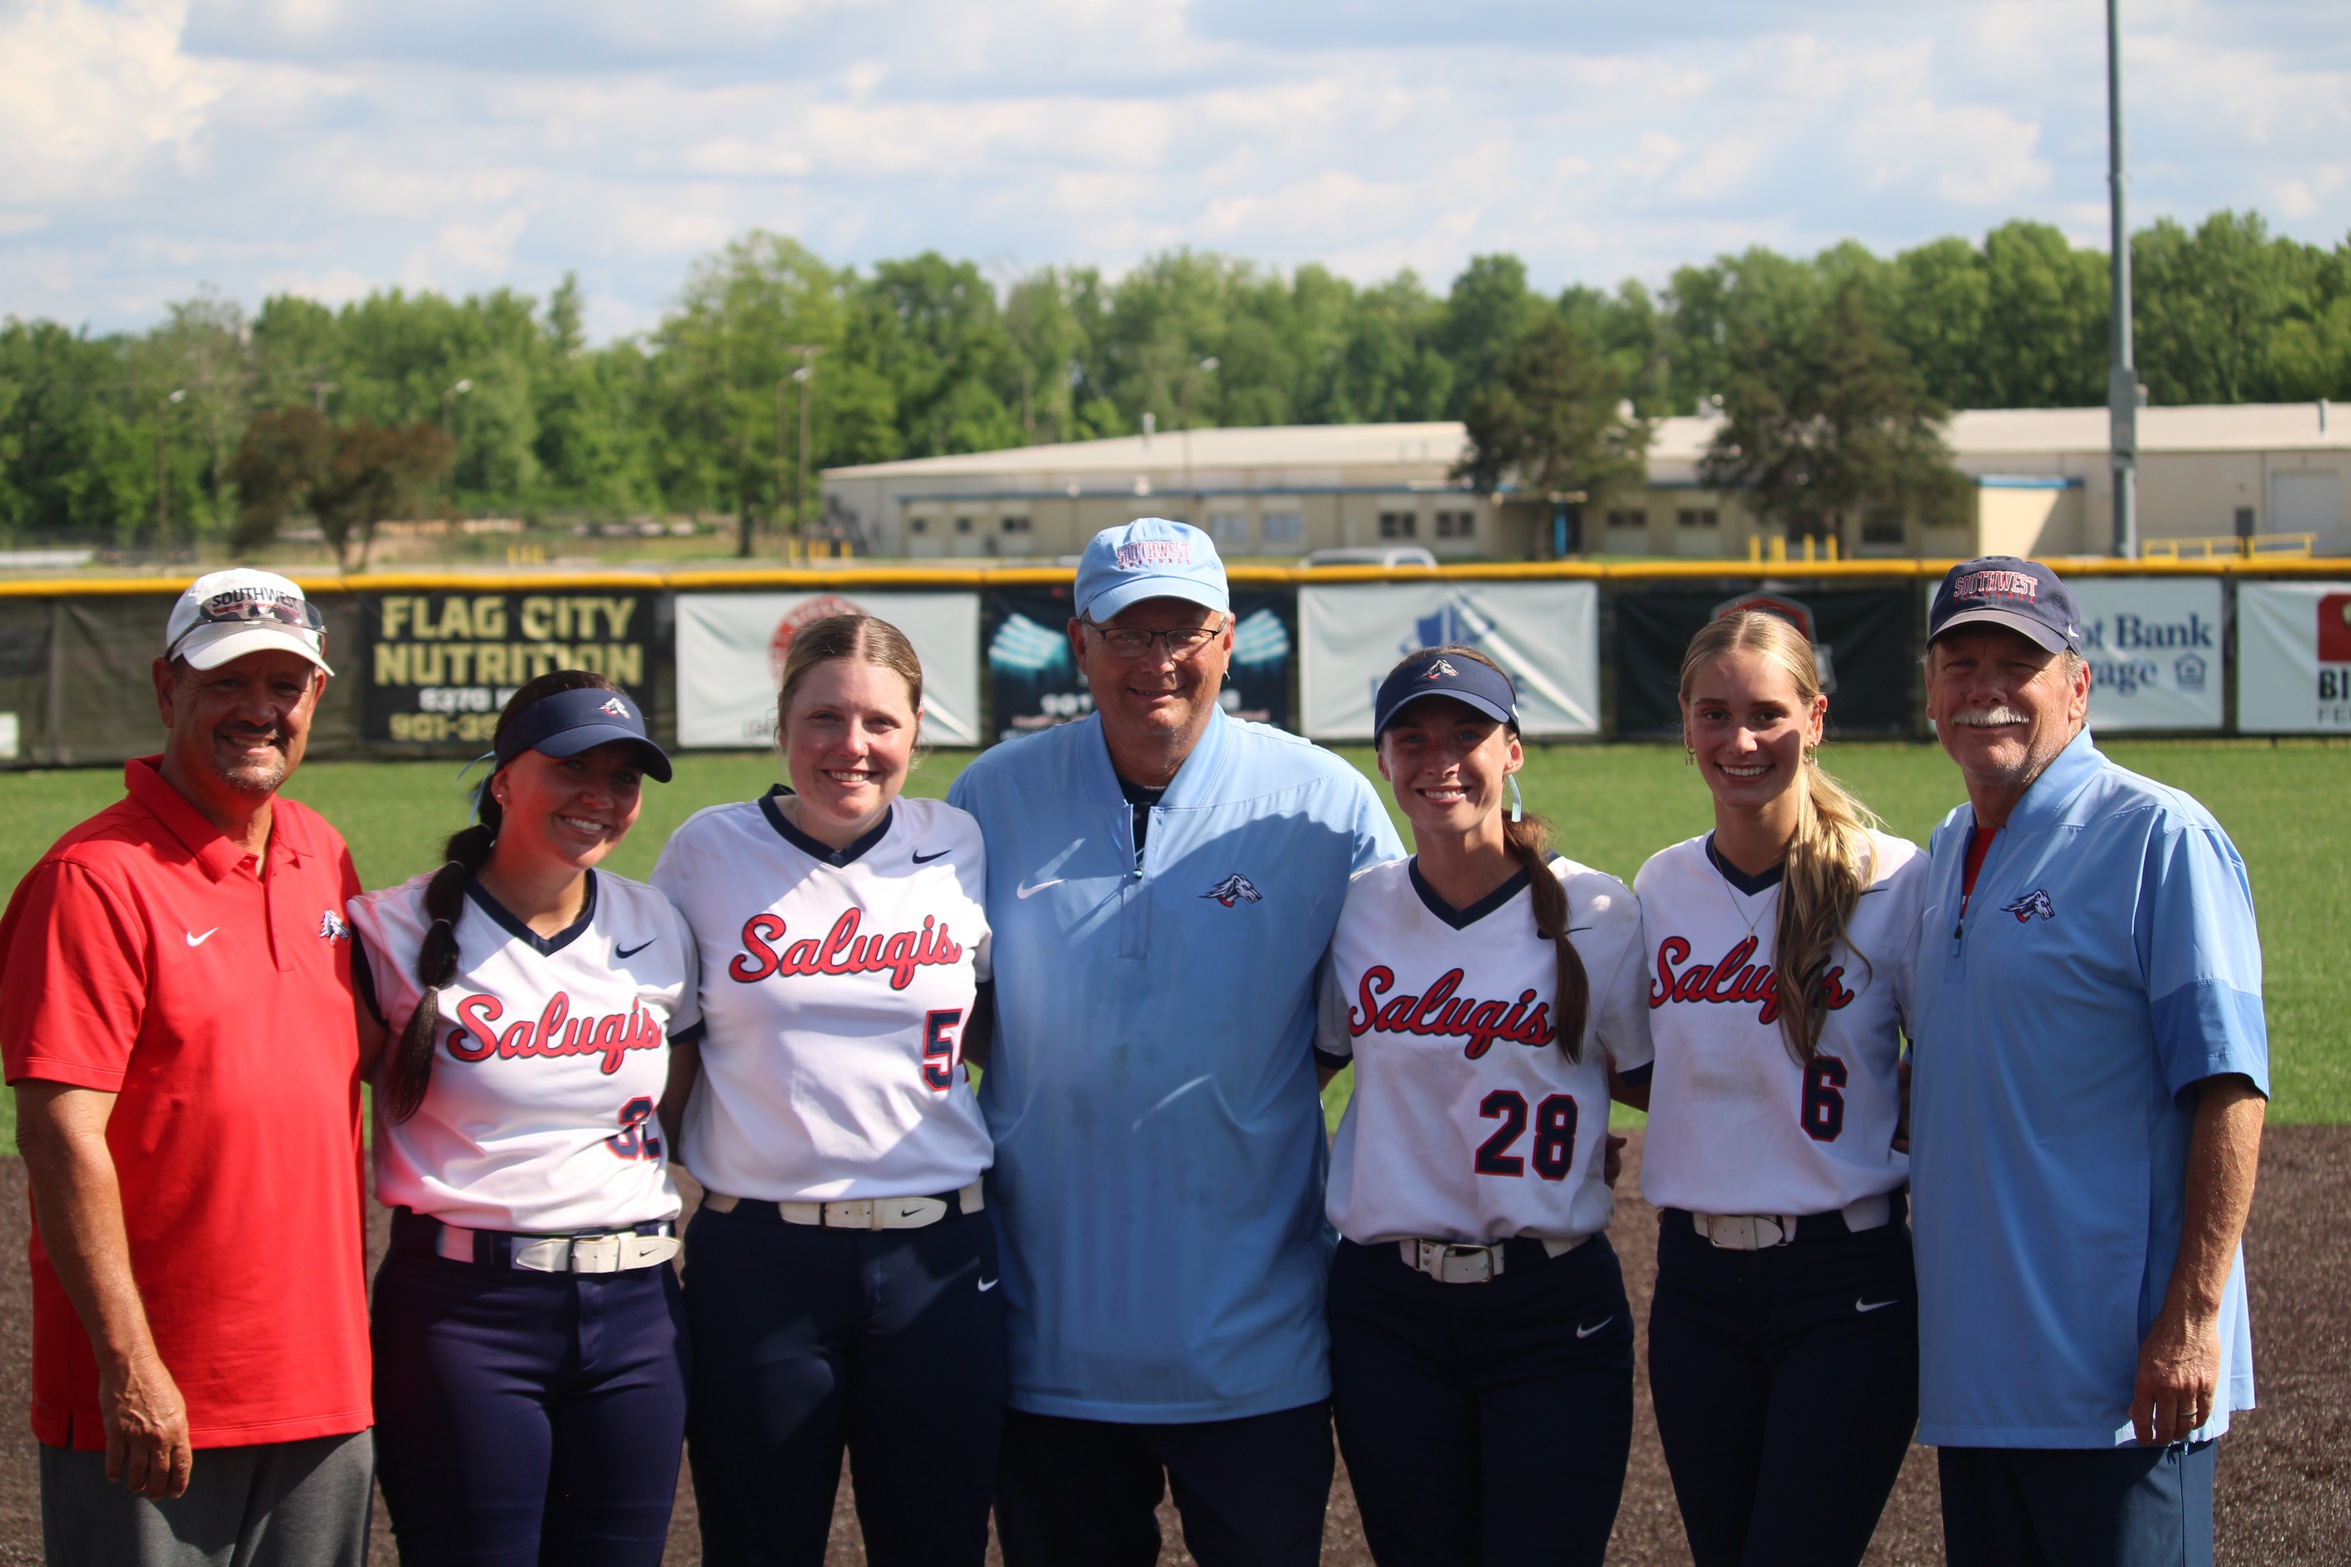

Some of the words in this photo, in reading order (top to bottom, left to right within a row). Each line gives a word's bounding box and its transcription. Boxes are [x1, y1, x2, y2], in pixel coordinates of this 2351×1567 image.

[1116, 541, 1191, 565] SOUTHWEST
[211, 587, 298, 610] SOUTHWEST
[1953, 570, 2038, 597] SOUTHWEST
[381, 596, 507, 639] FLAG
[521, 596, 638, 639] CITY
[2114, 611, 2212, 648] Bank
[2318, 669, 2351, 699] BI
[923, 1008, 967, 1092] 5
[1801, 1055, 1848, 1143] 6
[1474, 1089, 1578, 1182] 28
